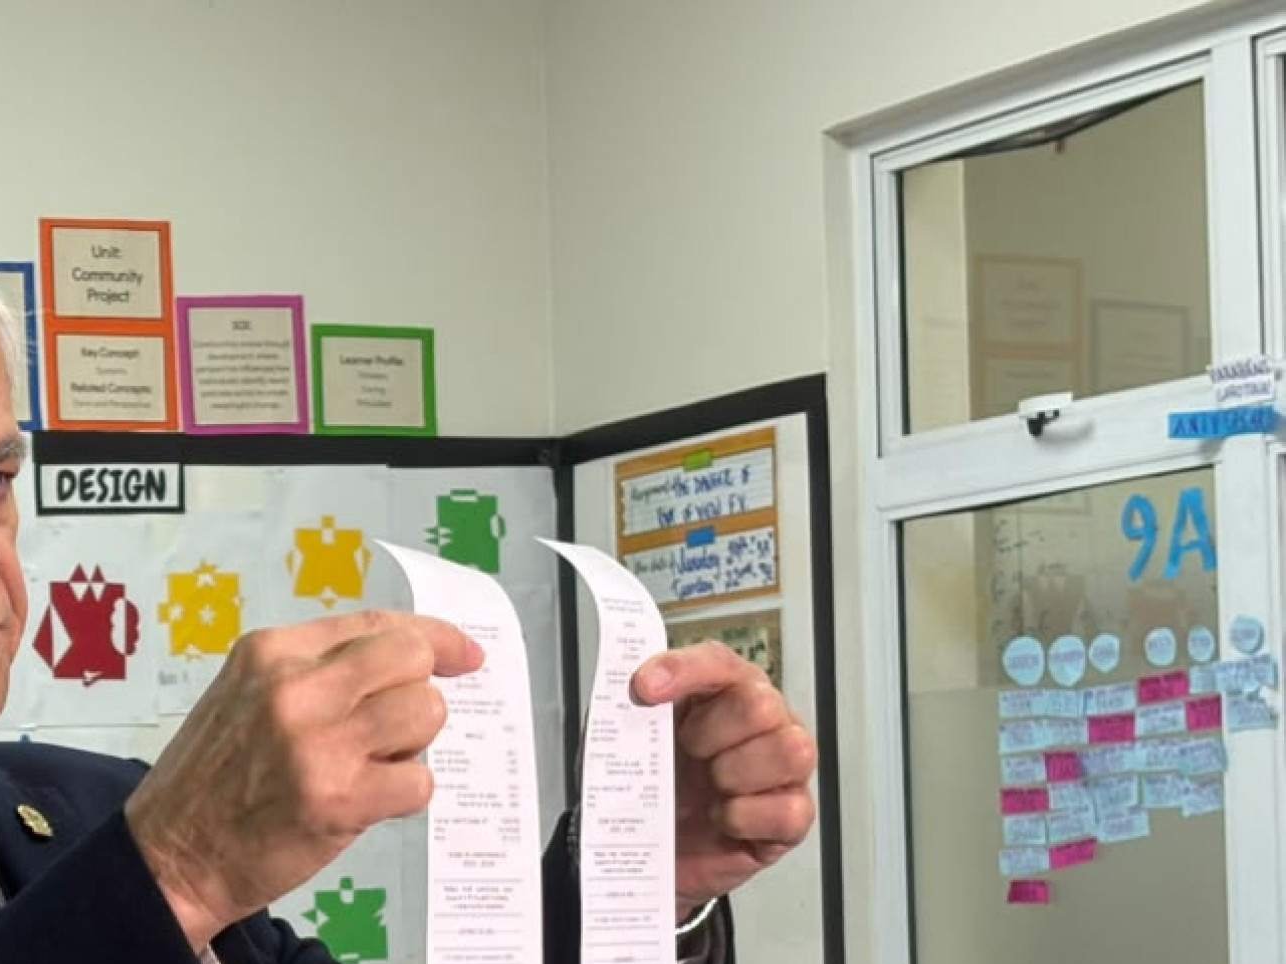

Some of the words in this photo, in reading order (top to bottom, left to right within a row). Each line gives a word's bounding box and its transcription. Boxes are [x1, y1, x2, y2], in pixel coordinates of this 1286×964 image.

[71, 266, 144, 286] Community
[86, 287, 130, 305] Project
[56, 467, 166, 503] DESIGN
[1121, 485, 1219, 583] 9A
